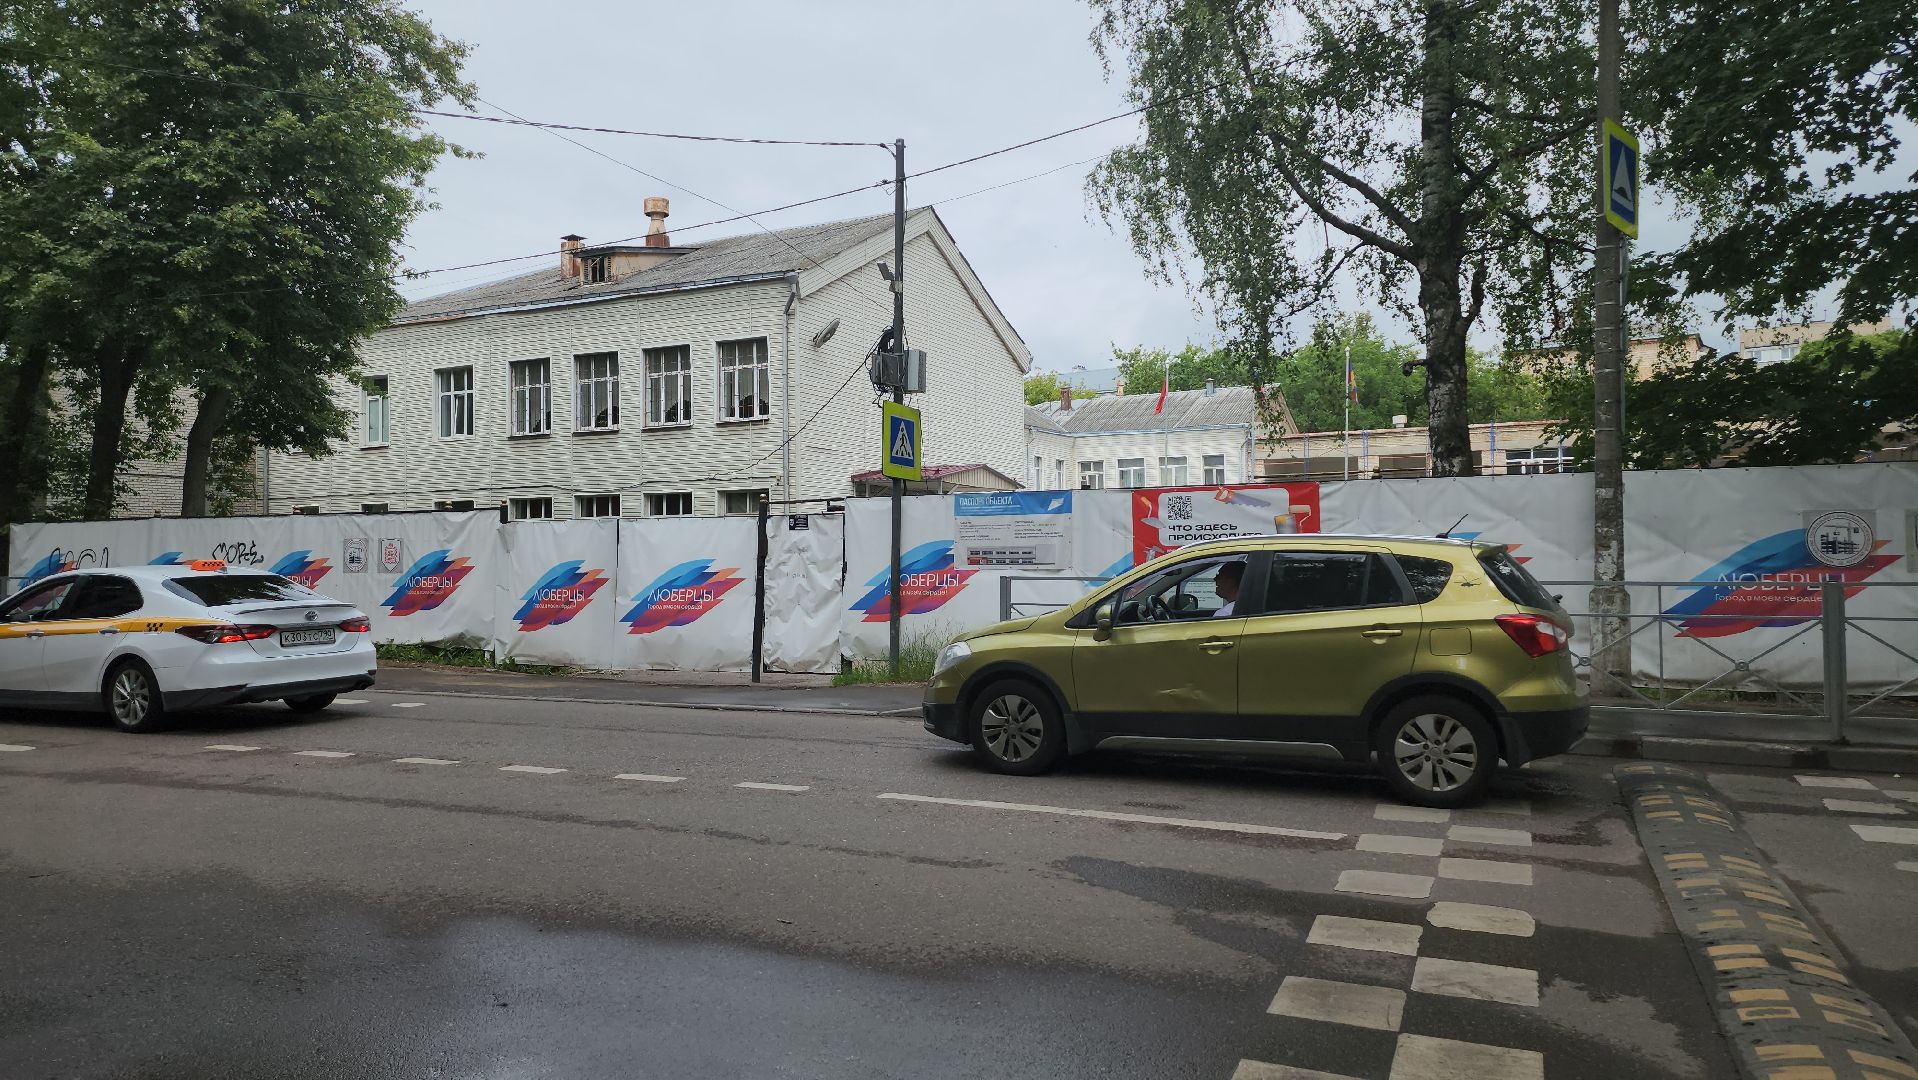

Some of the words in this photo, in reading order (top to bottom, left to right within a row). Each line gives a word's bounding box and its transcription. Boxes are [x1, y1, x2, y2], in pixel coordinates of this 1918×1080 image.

[1168, 524, 1192, 532] ЧТО
[1195, 523, 1238, 532] ЗДЕСЬ
[404, 575, 454, 589] ЛЮБЕРЦЫ
[533, 588, 585, 605] ЛЮБЕРЦЫ
[647, 588, 714, 604] ЛЮБЕРЦЫ
[1715, 593, 1746, 603] Город
